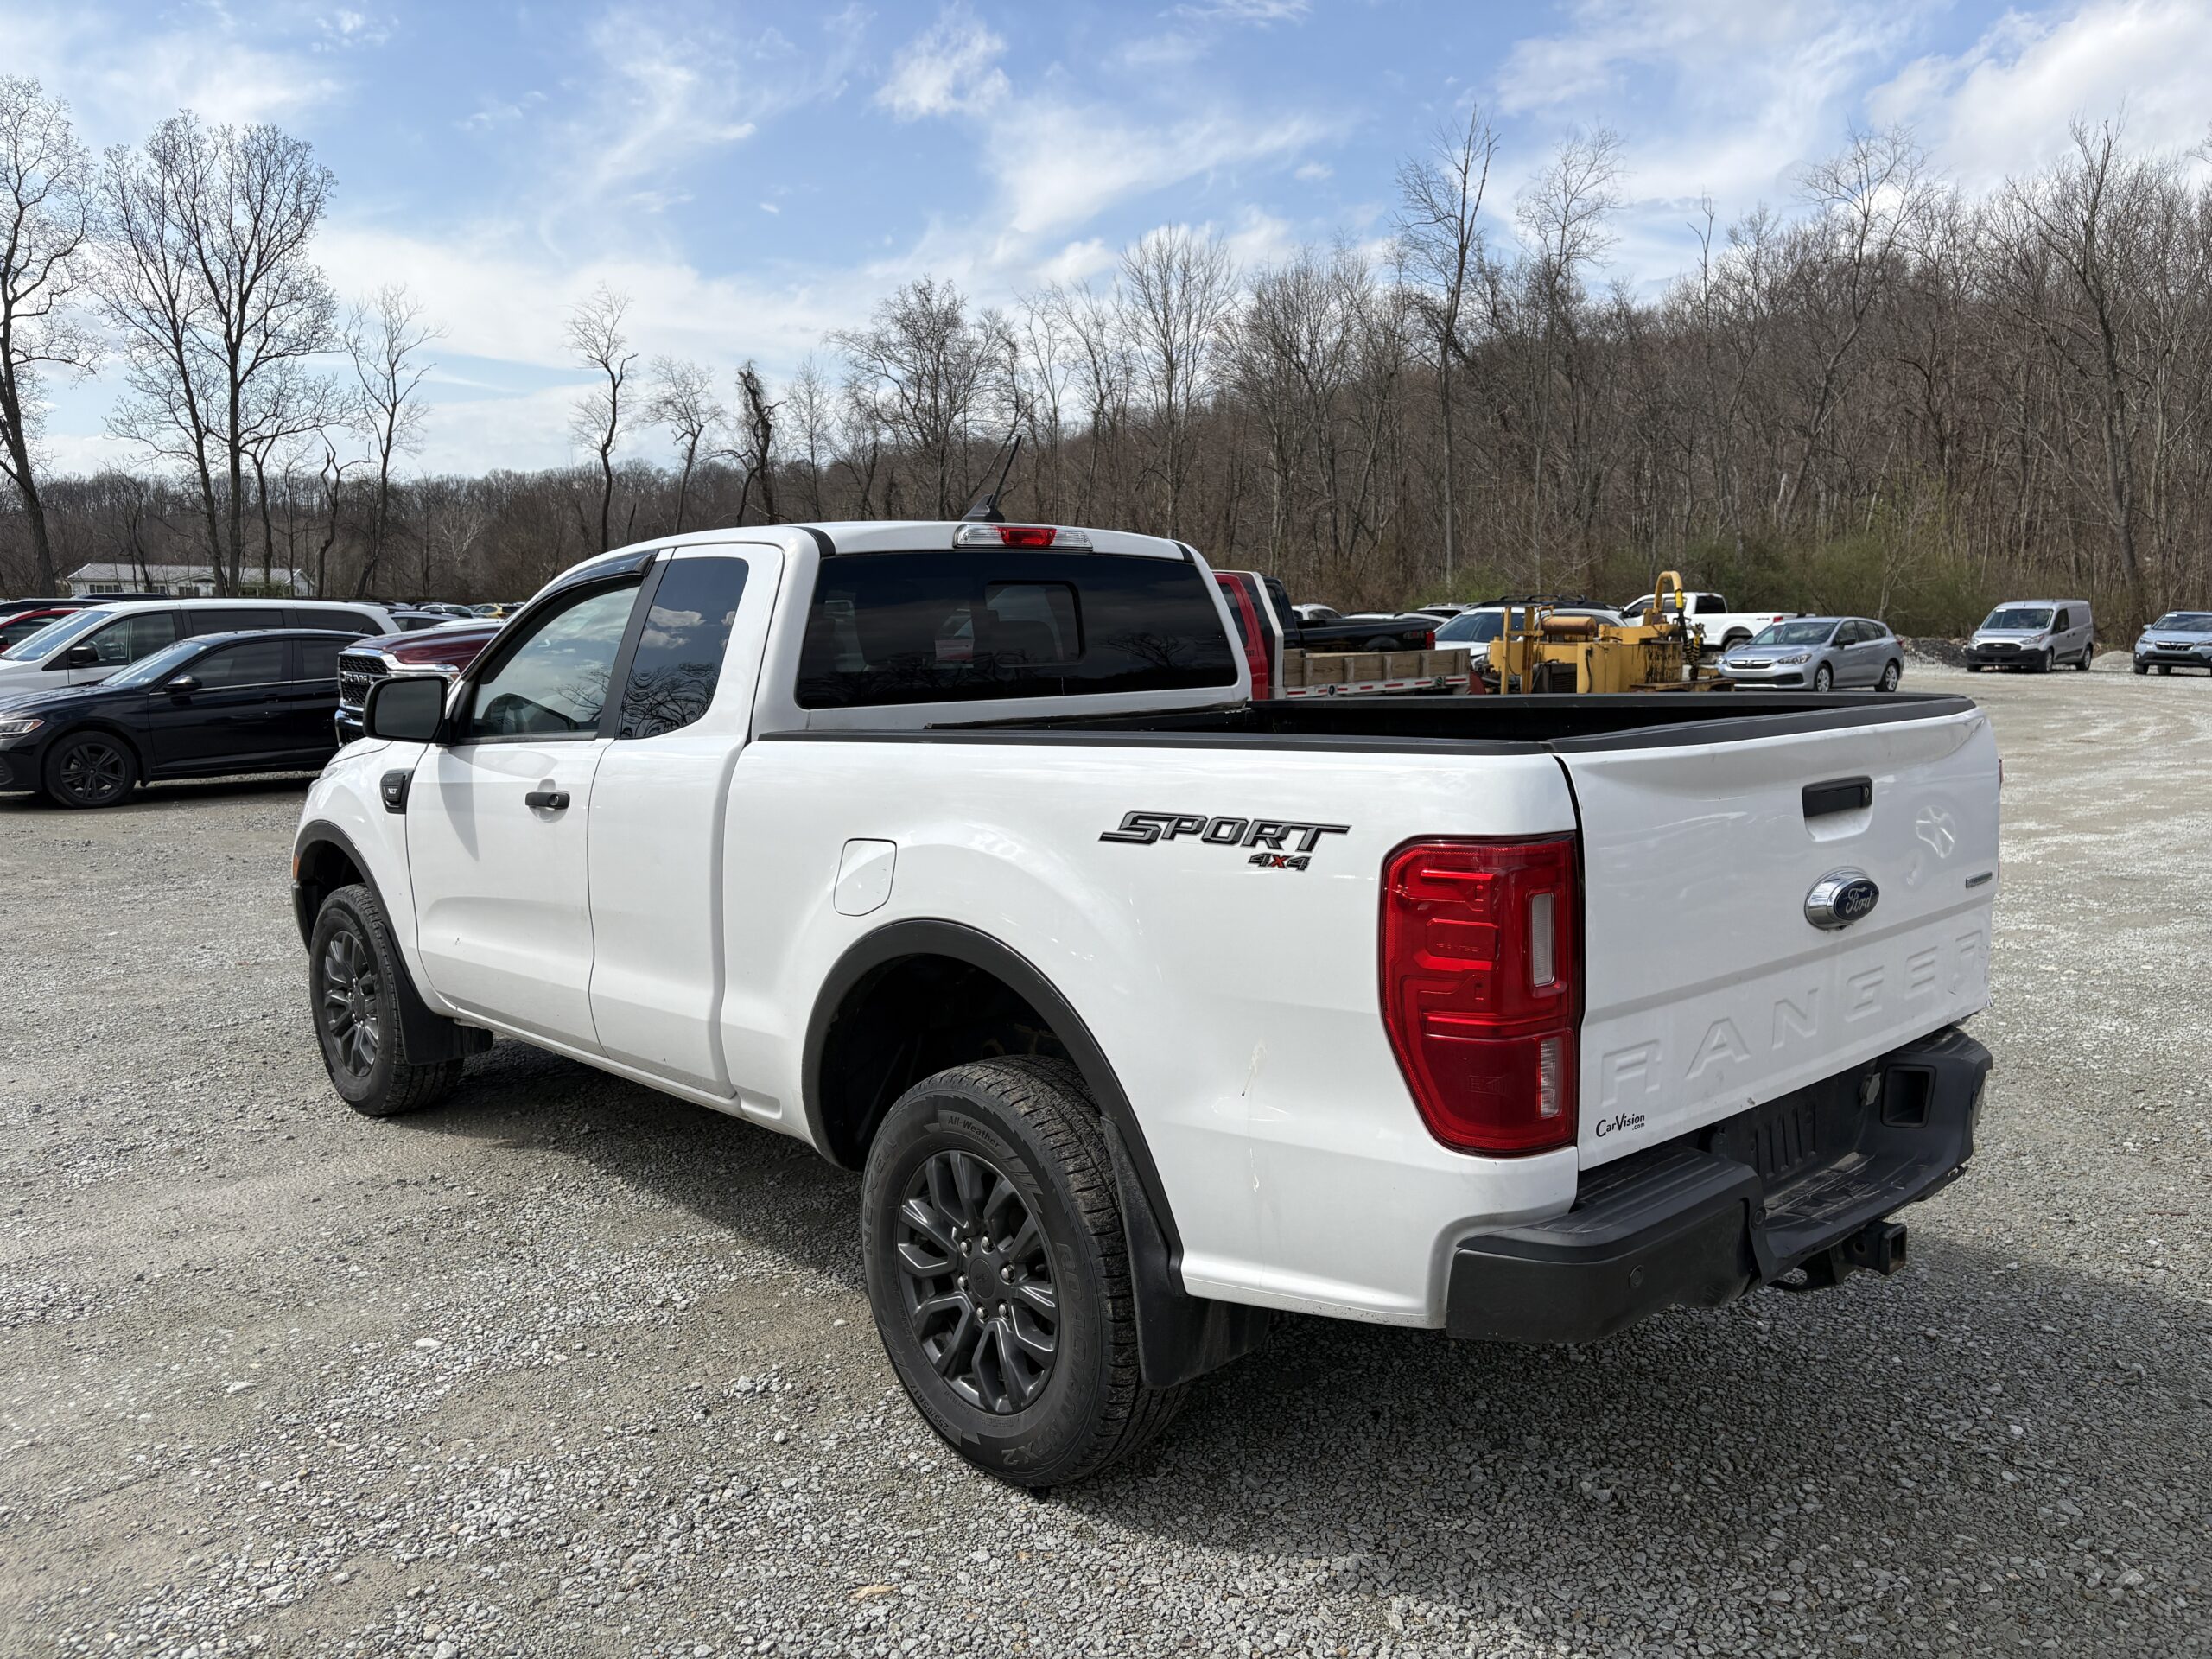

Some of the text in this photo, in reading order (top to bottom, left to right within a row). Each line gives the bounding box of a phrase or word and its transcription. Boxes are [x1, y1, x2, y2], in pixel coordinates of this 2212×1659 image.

[1098, 810, 1353, 853] SPORT
[1845, 887, 1873, 914] Ford
[1600, 929, 1984, 1109] RANGER
[1596, 1113, 1645, 1138] CarVision
[1631, 1122, 1645, 1131] .com
